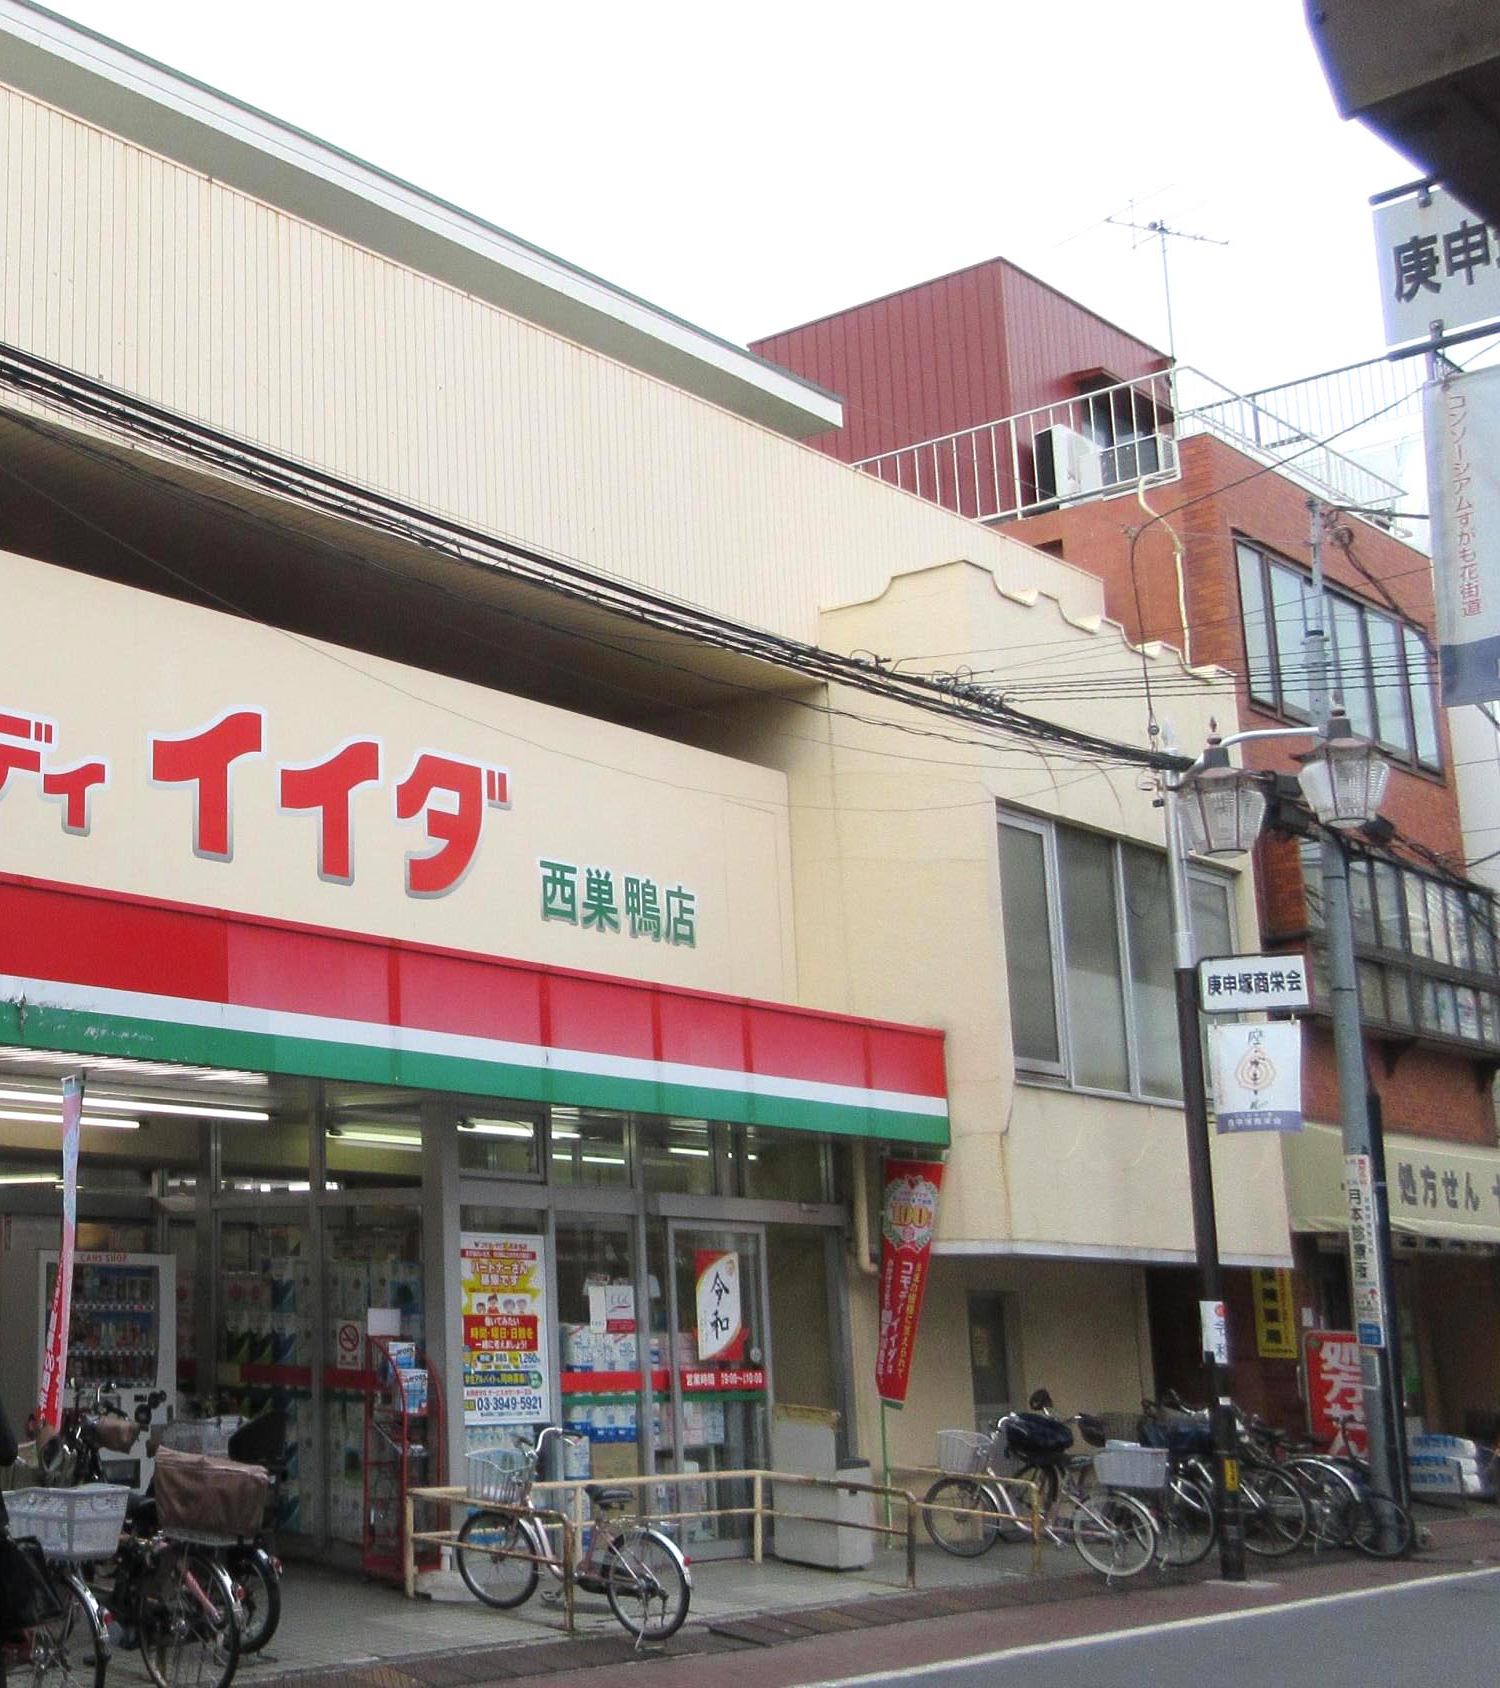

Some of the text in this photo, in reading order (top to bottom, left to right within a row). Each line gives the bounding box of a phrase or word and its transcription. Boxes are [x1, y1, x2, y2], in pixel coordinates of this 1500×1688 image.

[1393, 219, 1500, 304] 庚申
[1448, 395, 1483, 617] コンソーシアムすがも花街道
[538, 858, 697, 947] 西巣鴨店
[1207, 969, 1302, 996] 庚申塚商栄会
[1398, 1162, 1480, 1212] 処方せん
[709, 1271, 731, 1341] 令和
